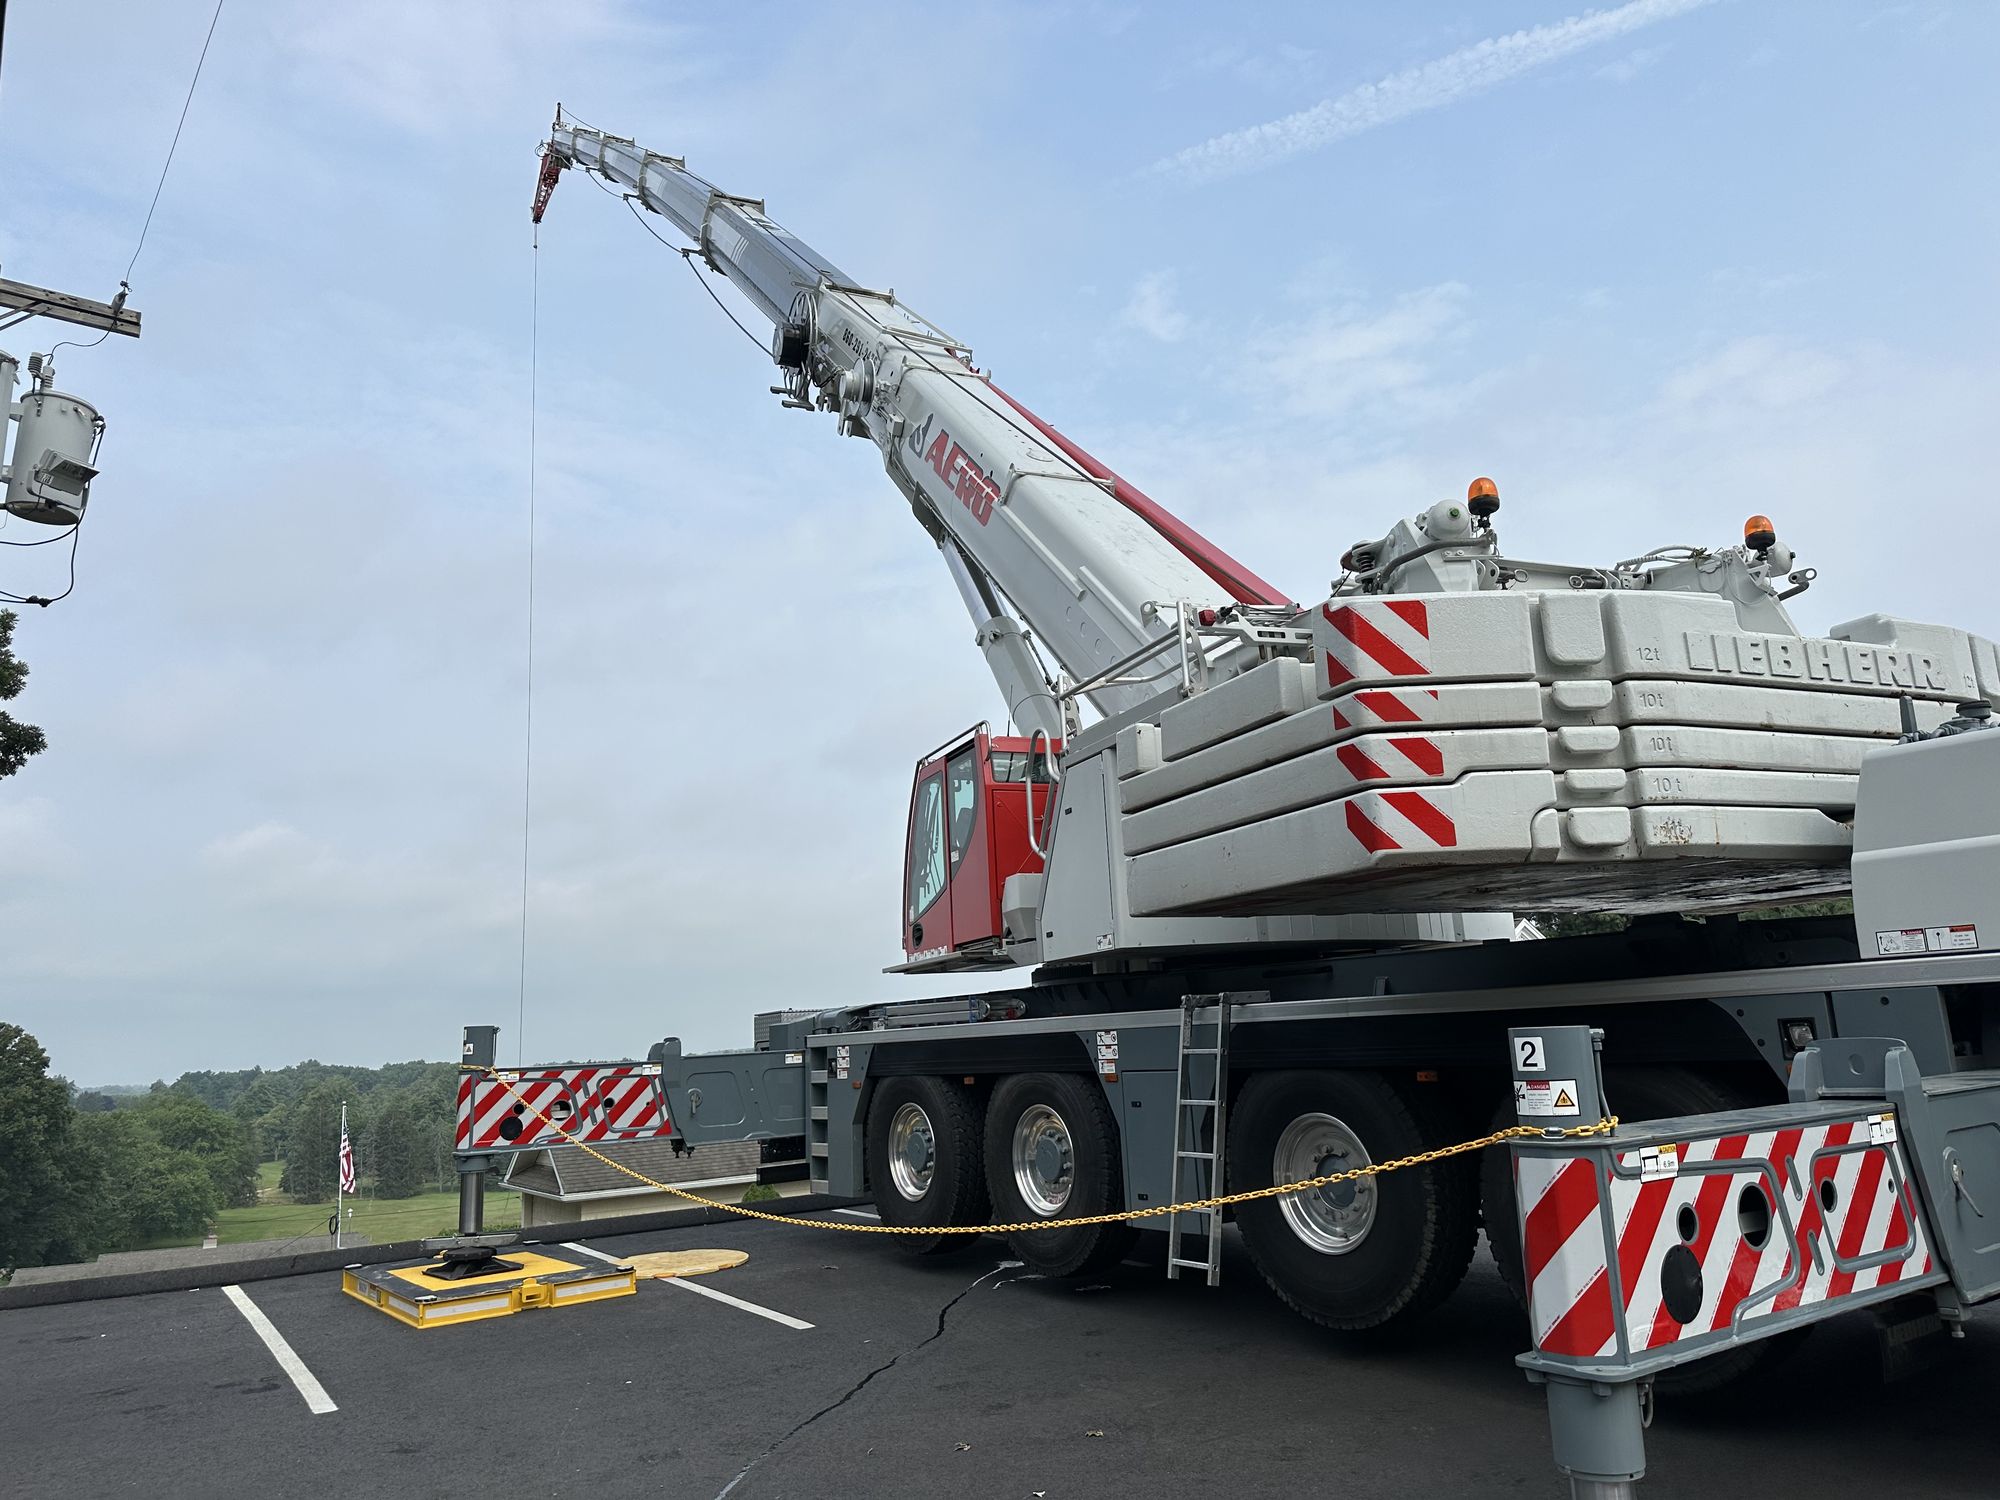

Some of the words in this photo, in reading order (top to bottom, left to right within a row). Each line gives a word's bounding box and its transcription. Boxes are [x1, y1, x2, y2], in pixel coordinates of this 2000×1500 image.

[924, 429, 1001, 527] AERO
[1636, 647, 1660, 661] 12t
[1684, 631, 1946, 690] LIEBHERR
[1640, 693, 1664, 707] 10t
[1650, 736, 1673, 751] 10t
[1521, 1041, 1538, 1067] 2
